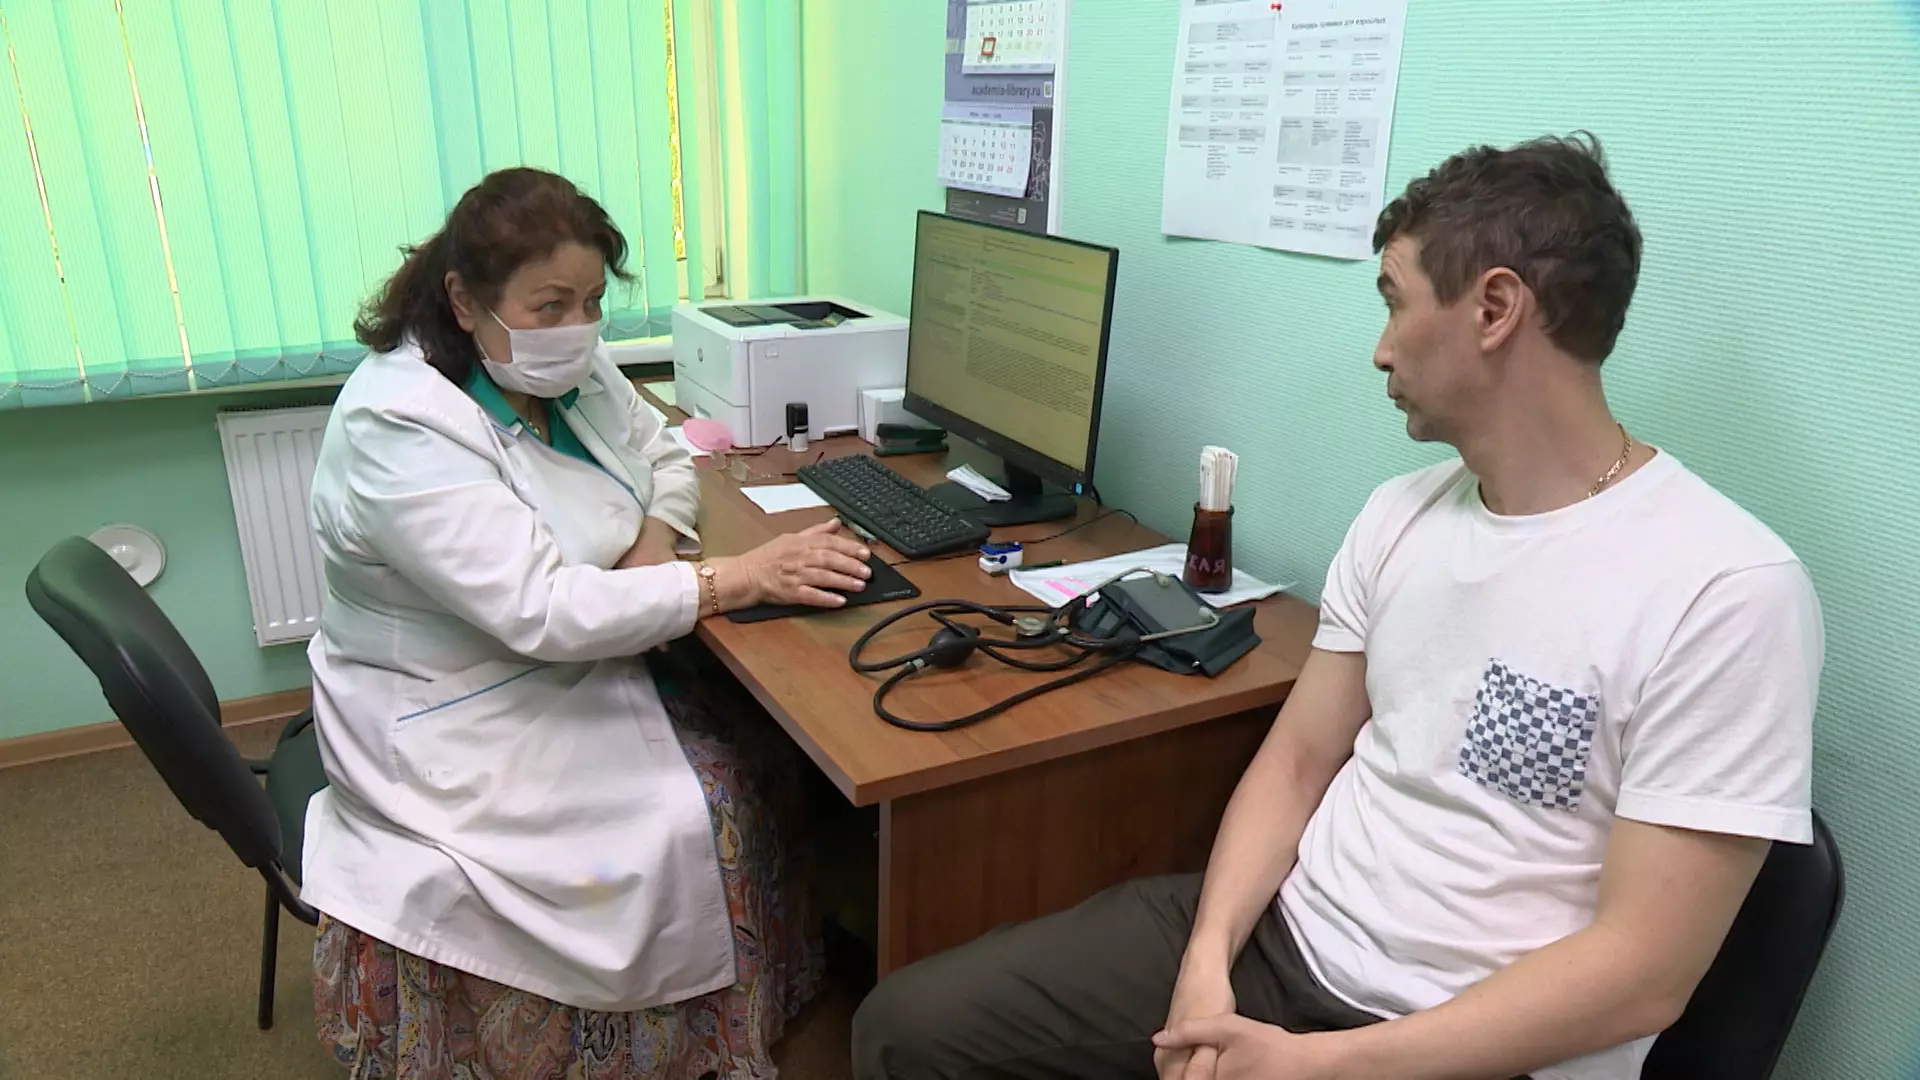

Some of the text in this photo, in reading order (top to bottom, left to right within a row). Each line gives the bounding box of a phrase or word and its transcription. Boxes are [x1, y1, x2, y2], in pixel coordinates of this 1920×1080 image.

[980, 19, 984, 27] 8
[990, 19, 994, 27] 9
[1027, 15, 1034, 23] 13
[1036, 28, 1043, 36] 21
[1000, 141, 1007, 150] 10
